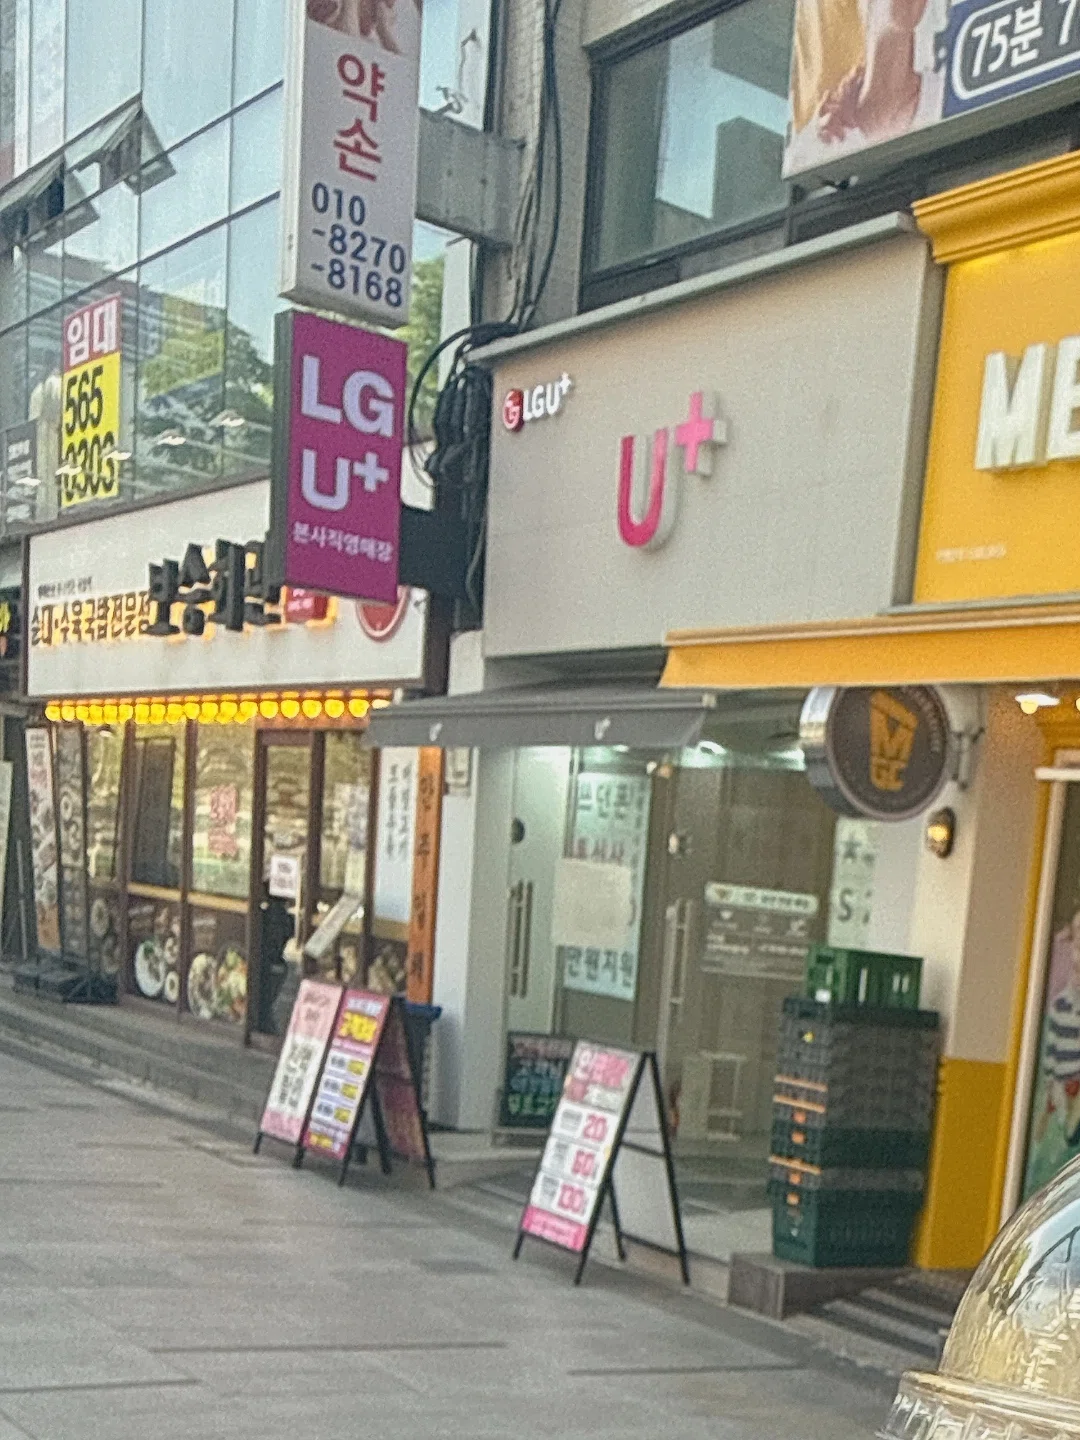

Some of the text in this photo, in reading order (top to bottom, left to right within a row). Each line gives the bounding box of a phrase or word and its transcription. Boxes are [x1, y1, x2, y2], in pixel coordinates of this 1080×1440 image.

[971, 0, 1044, 77] 75분
[333, 53, 386, 182] 약손
[311, 182, 366, 227] 010
[312, 223, 406, 275] -8270
[311, 258, 403, 308] -8168
[66, 299, 120, 367] 임대
[65, 364, 104, 427] 565
[301, 354, 395, 438] LG
[301, 448, 389, 511] U+
[617, 391, 728, 549] U+
